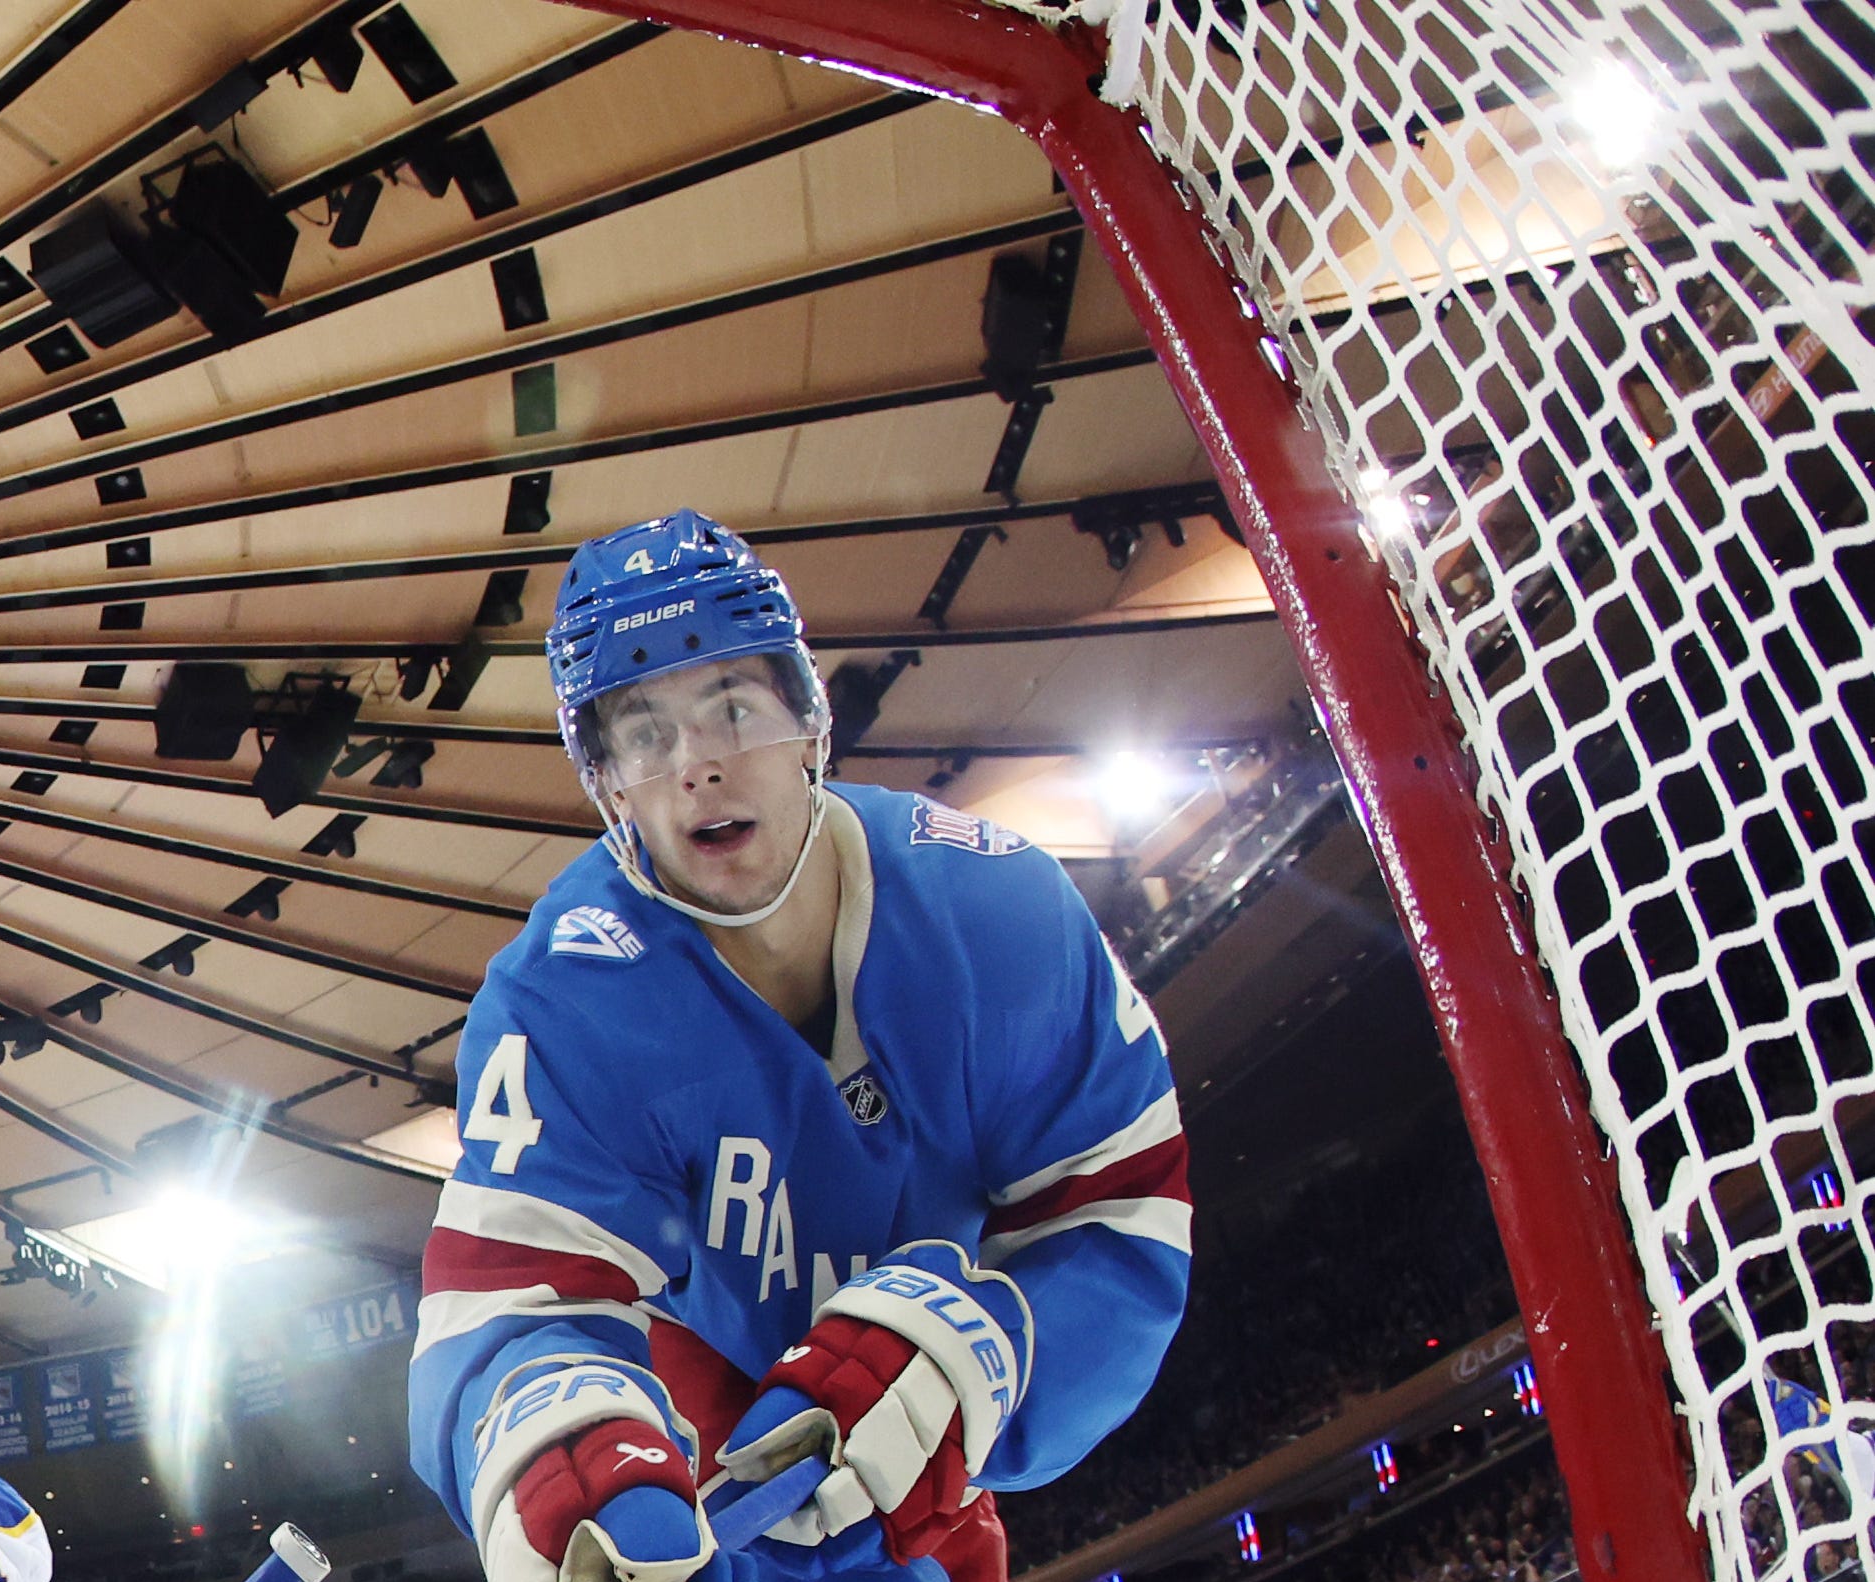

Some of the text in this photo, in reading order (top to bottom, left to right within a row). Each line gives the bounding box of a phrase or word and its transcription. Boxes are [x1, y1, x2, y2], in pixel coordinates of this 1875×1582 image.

[624, 549, 654, 576] 4
[613, 599, 696, 634] BAUER
[463, 1034, 542, 1175] 4
[344, 1293, 405, 1344] 104
